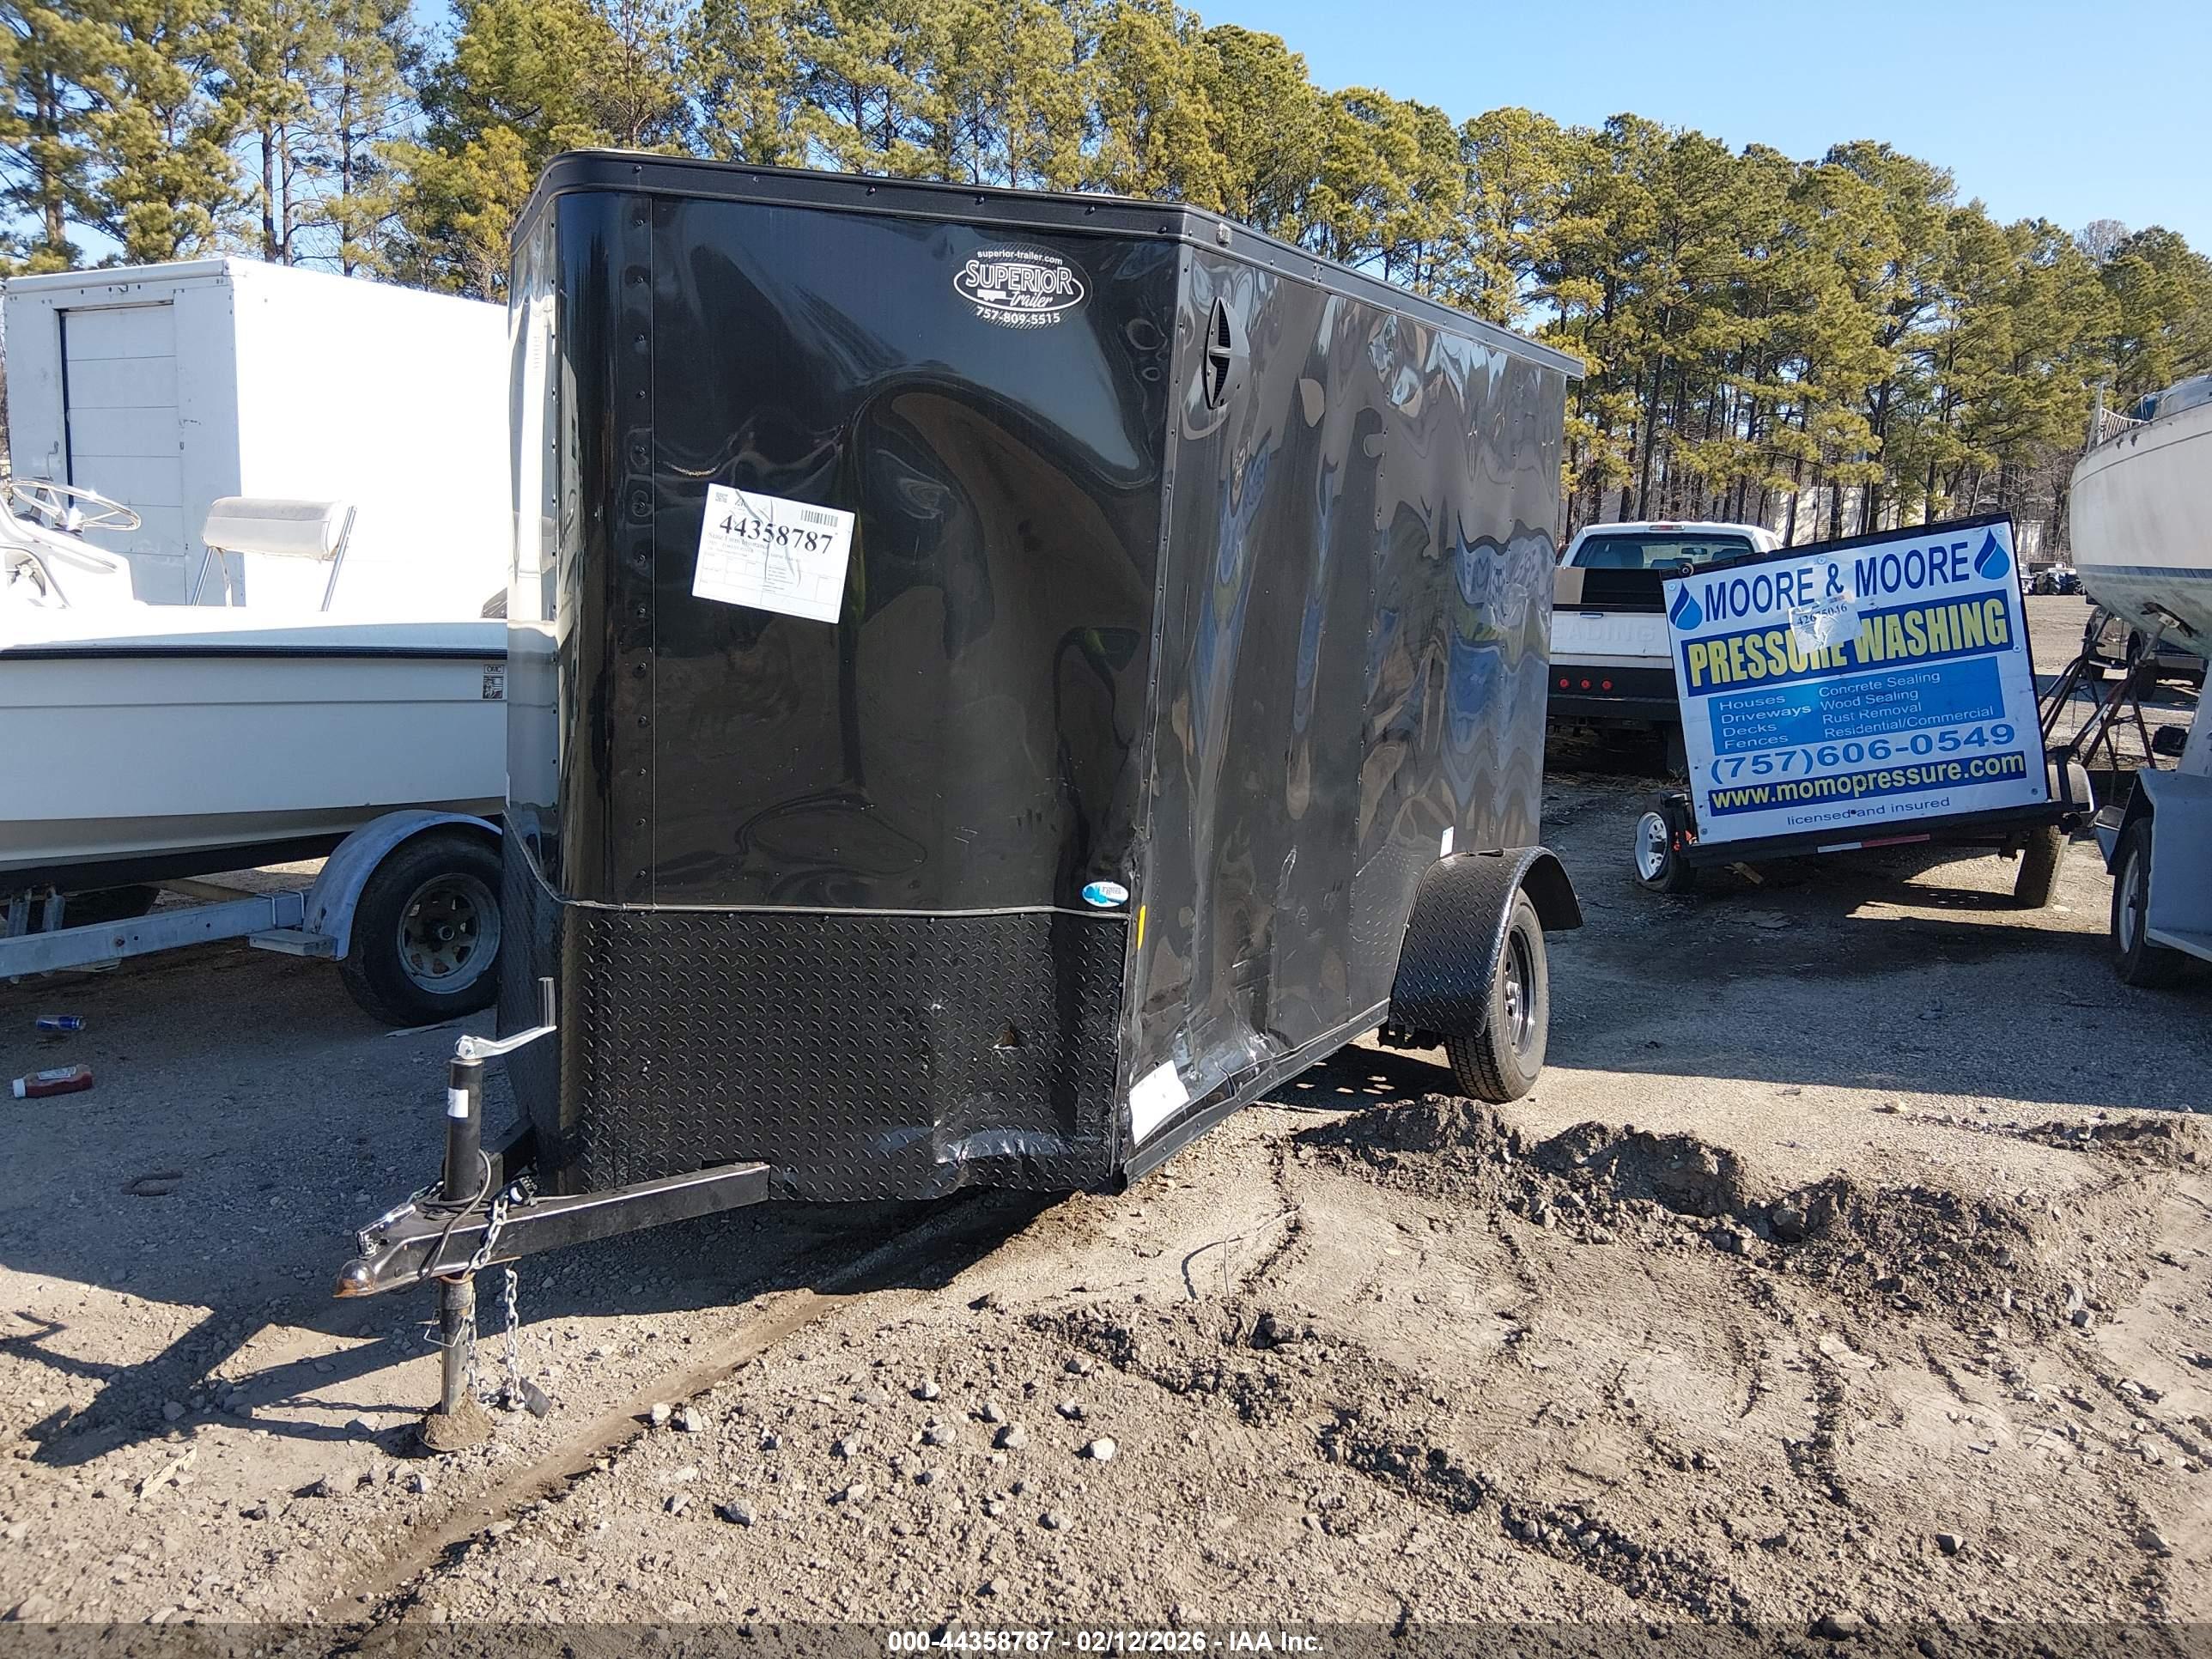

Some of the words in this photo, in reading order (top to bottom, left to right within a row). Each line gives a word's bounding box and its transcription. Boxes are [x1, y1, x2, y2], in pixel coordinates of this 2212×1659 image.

[977, 249, 1063, 265] superior-trailer.com
[965, 259, 1074, 295] SUPERIOR
[976, 306, 1060, 325] 757-809-5515
[720, 514, 834, 554] 44358787
[1705, 568, 1814, 622] MOORE
[1826, 562, 1844, 598] &
[1855, 542, 1970, 598] MOORE
[1854, 598, 2008, 664] WASHING
[1819, 679, 1882, 697] Concrete
[1887, 672, 1941, 688] Sealing
[1719, 695, 1786, 711] Houses
[1820, 694, 1861, 711] Wood
[1865, 690, 1918, 705] Sealing
[1721, 705, 1812, 724] Driveways
[1822, 711, 1855, 725] Rust
[1859, 702, 1922, 720] Removal
[1825, 706, 1994, 738] Residential/Commercial
[1723, 723, 1778, 738] Decks
[1724, 734, 1789, 750] Fences
[1711, 724, 2015, 784] (757)606-0549
[1711, 754, 2024, 808] www.momopressure.com
[1787, 809, 1851, 825] licensed
[1856, 805, 1886, 817] and
[1891, 797, 1950, 812] insured
